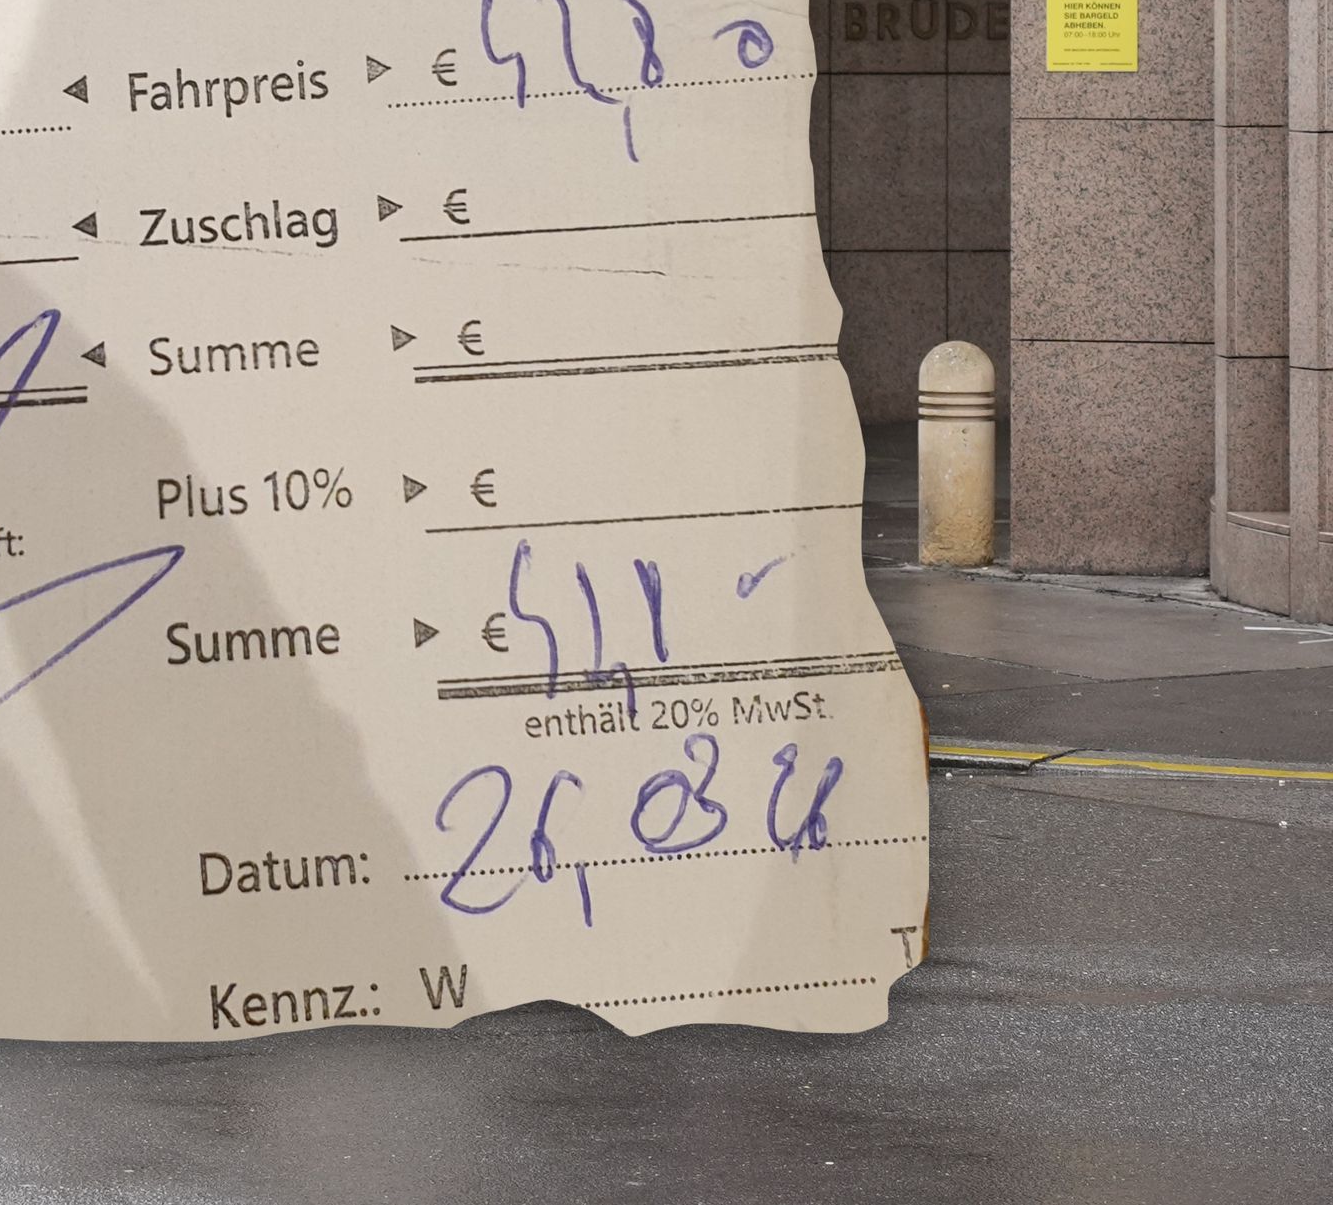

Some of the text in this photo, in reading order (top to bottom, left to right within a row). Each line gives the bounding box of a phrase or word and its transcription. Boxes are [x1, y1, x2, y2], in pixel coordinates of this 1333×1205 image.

[1064, 12, 1119, 20] SIE BARGELD
[1086, 1, 1121, 10] KÖNNEN
[127, 59, 329, 119] Fahrpreis
[138, 199, 339, 249] Zuschlag
[148, 336, 320, 377] Summe
[157, 474, 248, 520] Plus
[263, 466, 353, 512] 10%
[166, 621, 340, 666] Summe
[518, 690, 834, 741] enthält 20% MwSt.
[198, 850, 371, 897] Datum:
[209, 982, 386, 1033] Kennz.:
[418, 963, 468, 1011] W
